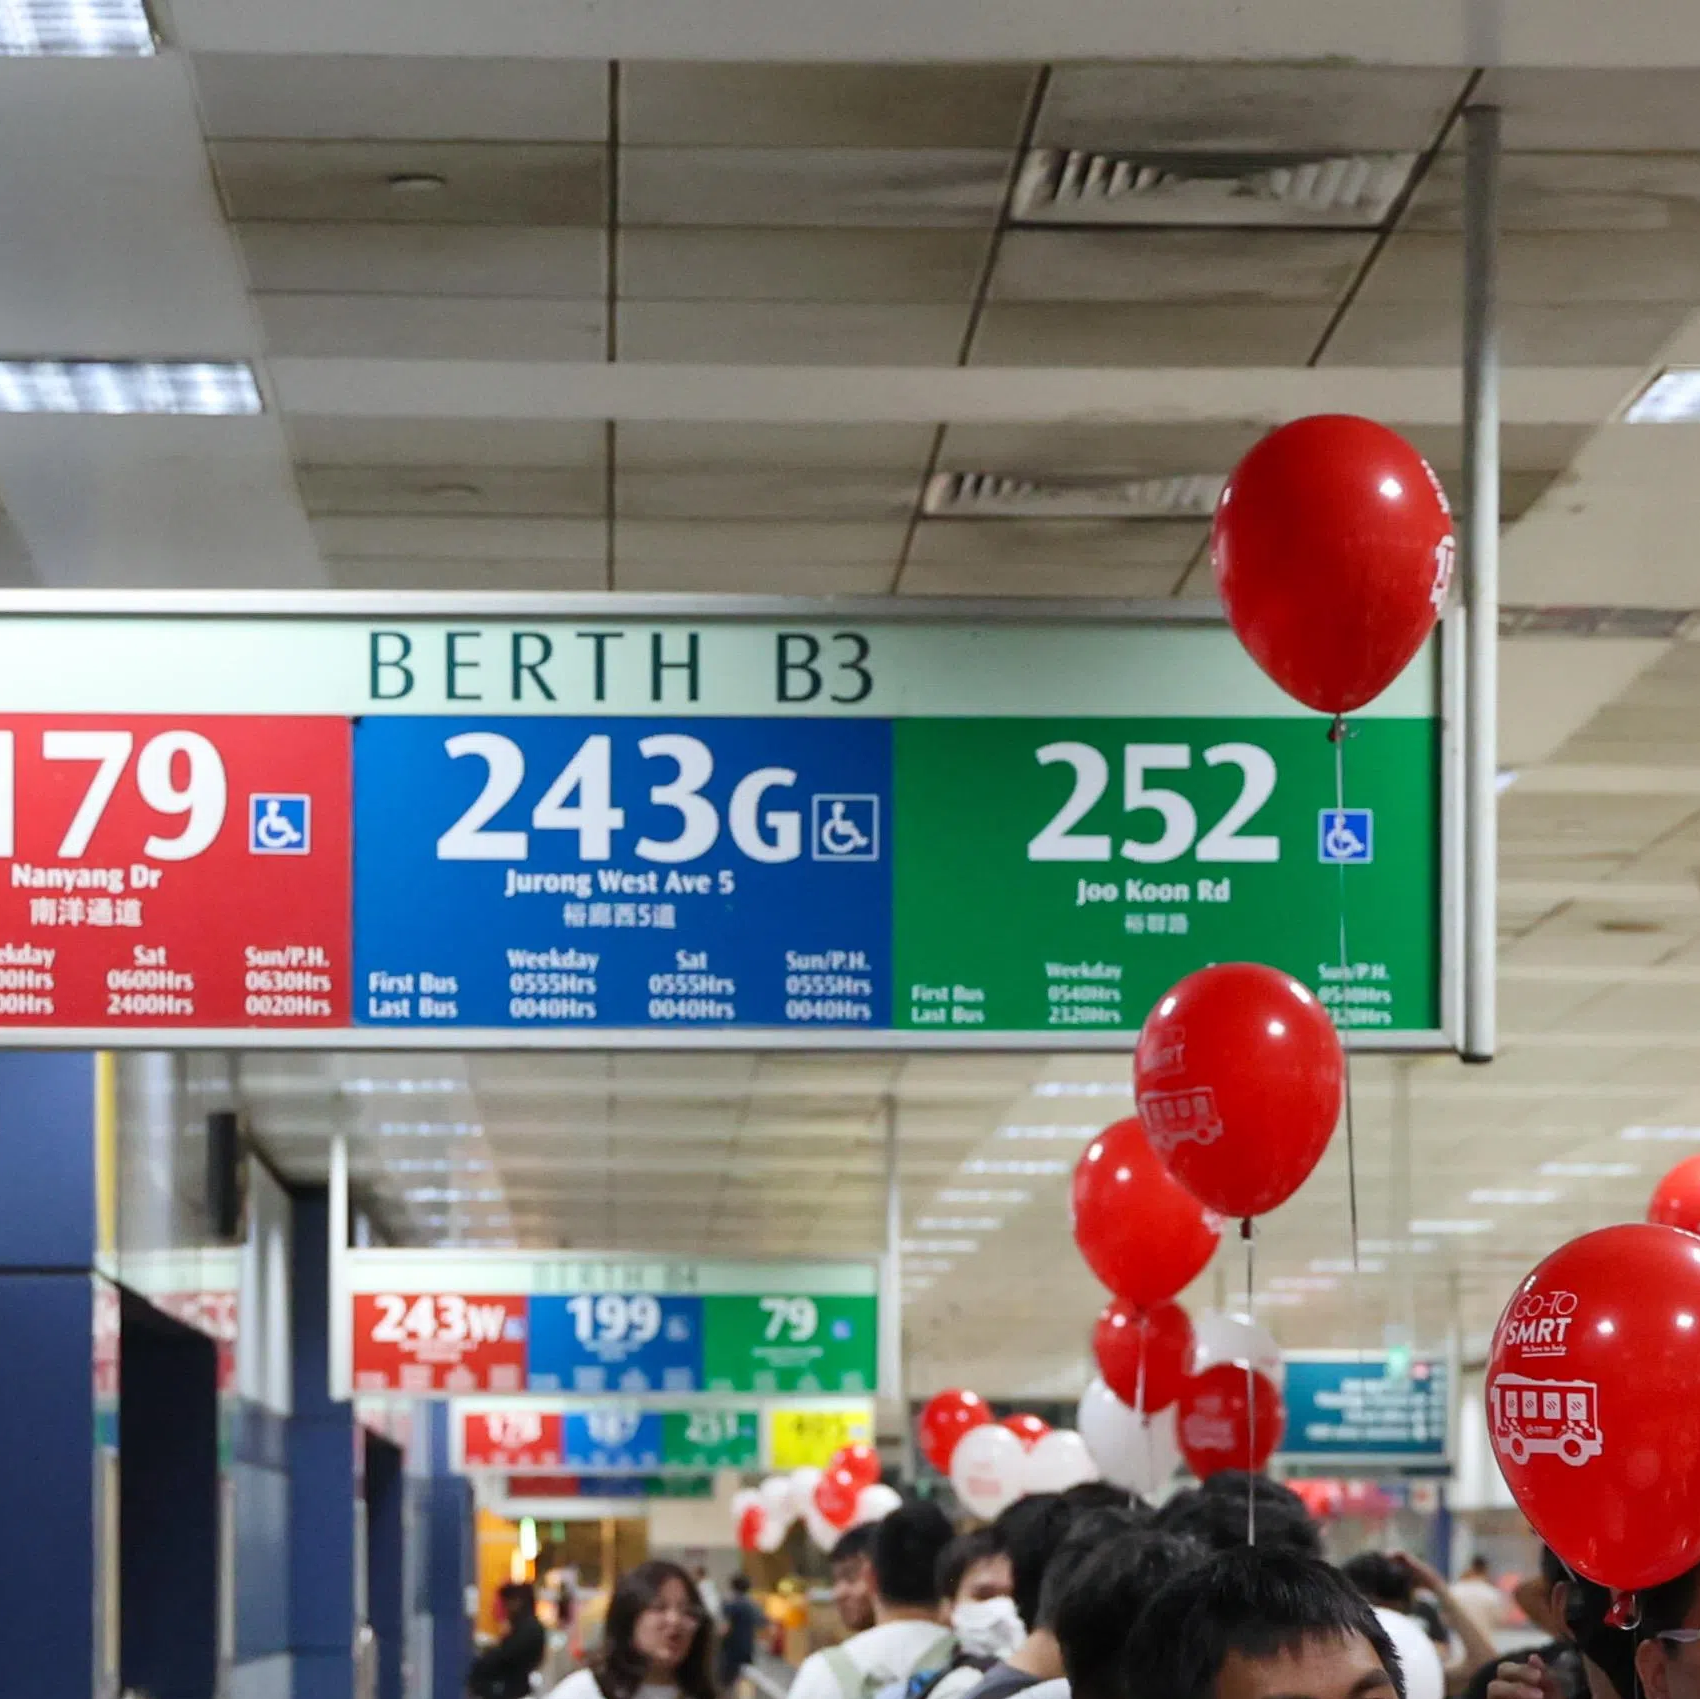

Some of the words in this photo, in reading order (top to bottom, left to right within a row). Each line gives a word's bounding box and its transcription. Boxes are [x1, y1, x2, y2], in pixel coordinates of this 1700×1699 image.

[368, 631, 701, 703] BERTH
[775, 631, 876, 704] B3
[436, 731, 802, 862] 243G
[1027, 741, 1281, 864] 252
[11, 864, 126, 892] Nanyang
[131, 864, 163, 889] Dr
[505, 869, 593, 897] Jurong
[598, 870, 660, 895] West
[664, 870, 712, 895] Ave
[718, 870, 735, 895] 5
[1076, 879, 1118, 906] Joo
[1126, 878, 1190, 902] Koon
[1197, 878, 1231, 902] Rd
[30, 897, 143, 927] 南洋通道
[133, 945, 167, 966] Sat
[244, 945, 330, 967] Sun/P.H.
[506, 949, 600, 974] Weekday
[675, 950, 708, 971] Sat
[785, 950, 872, 972] Sun/P.H.
[106, 970, 194, 991] 0600Hrs
[244, 970, 332, 992] 0630Hrs
[368, 972, 414, 994] First
[419, 973, 458, 994] Bus
[509, 974, 597, 995] 0555Hrs
[648, 974, 735, 995] 0555Hrs
[785, 974, 872, 996] 0555Hrs
[1045, 962, 1123, 982] Weekday
[106, 994, 194, 1016] 2400Hrs
[244, 994, 332, 1016] 0020Hrs
[911, 985, 949, 1003] First
[952, 985, 985, 1003] Bus
[368, 997, 411, 1019] Last
[418, 997, 458, 1019] Bus
[509, 998, 597, 1020] 0040Hrs
[648, 998, 735, 1020] 0040Hrs
[785, 998, 872, 1021] 0040Hrs
[911, 1006, 949, 1023] Last
[952, 1006, 985, 1024] Bus
[370, 1294, 507, 1342] 243W
[565, 1295, 661, 1341] 199
[758, 1296, 819, 1341] 79
[1513, 1291, 1578, 1318] GO-TO
[1505, 1317, 1573, 1345] SMRT
